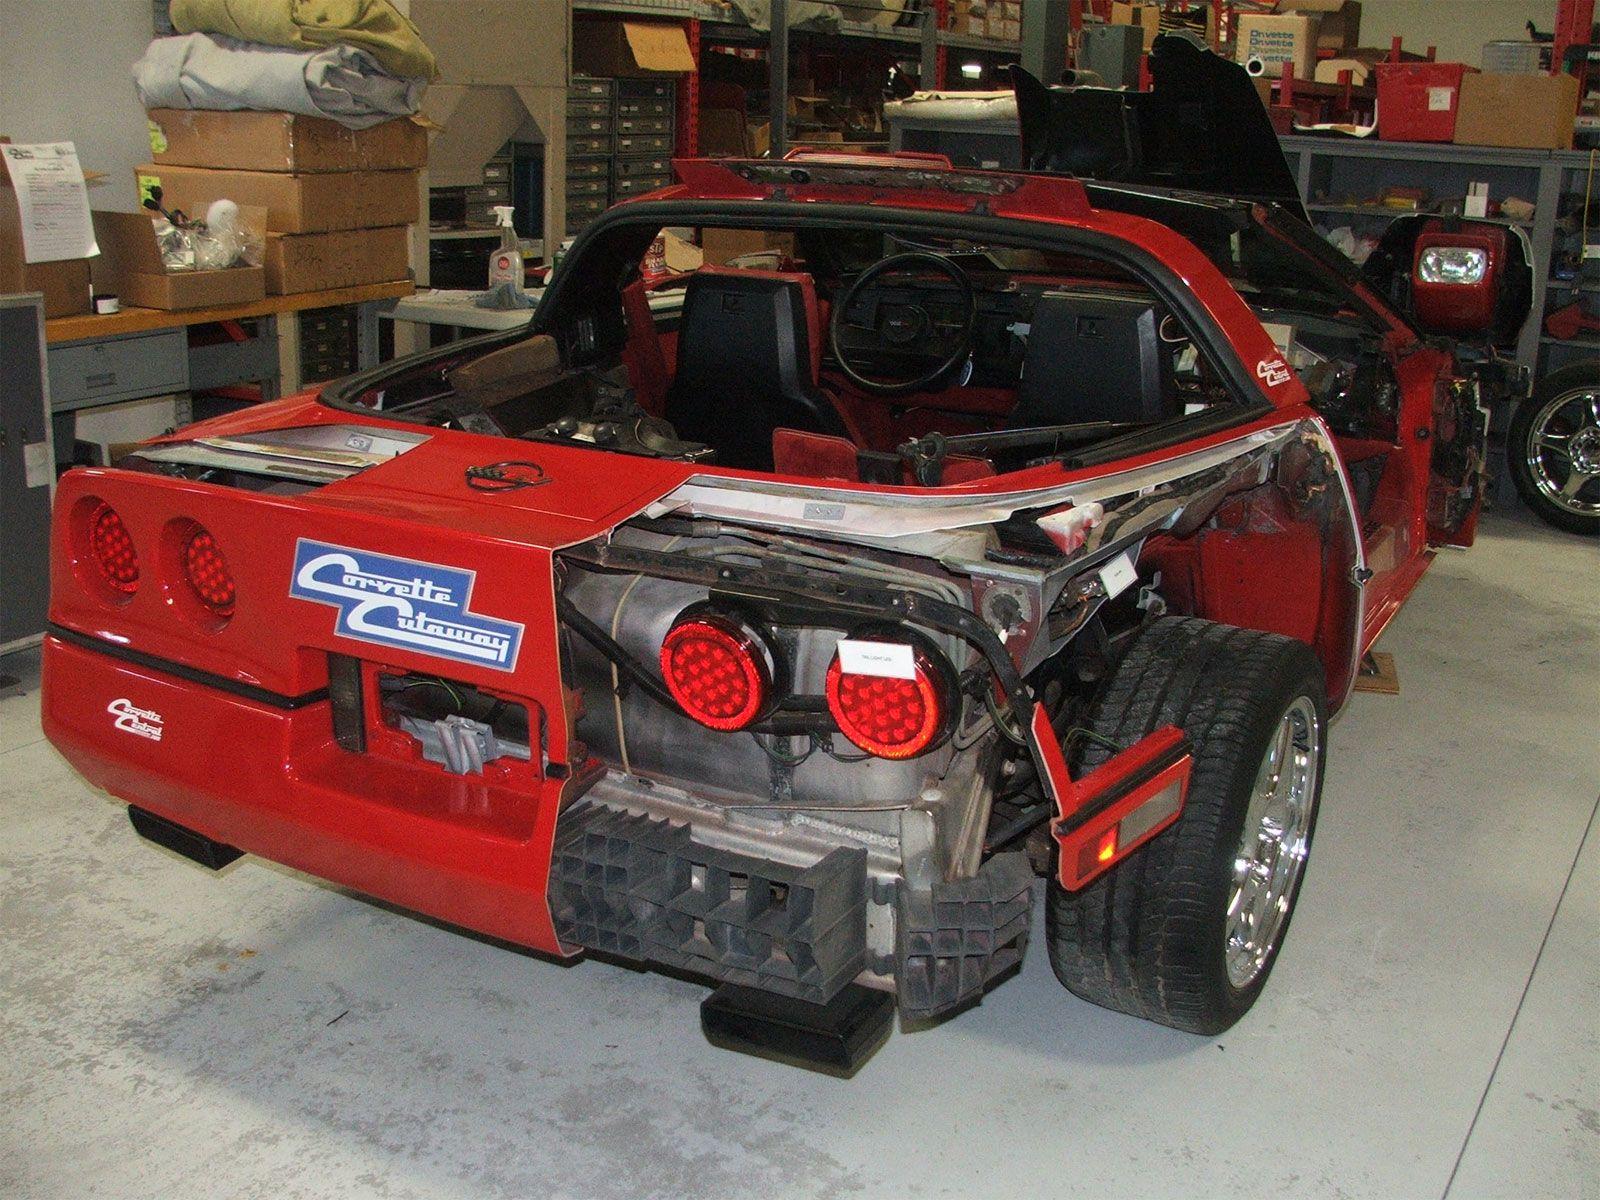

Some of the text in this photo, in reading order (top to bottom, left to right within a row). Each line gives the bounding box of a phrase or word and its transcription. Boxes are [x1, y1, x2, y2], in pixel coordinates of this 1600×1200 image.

[297, 553, 458, 606] Corvette
[347, 597, 511, 662] Cutaway
[107, 698, 164, 724] Corvette
[115, 714, 163, 741] Central
